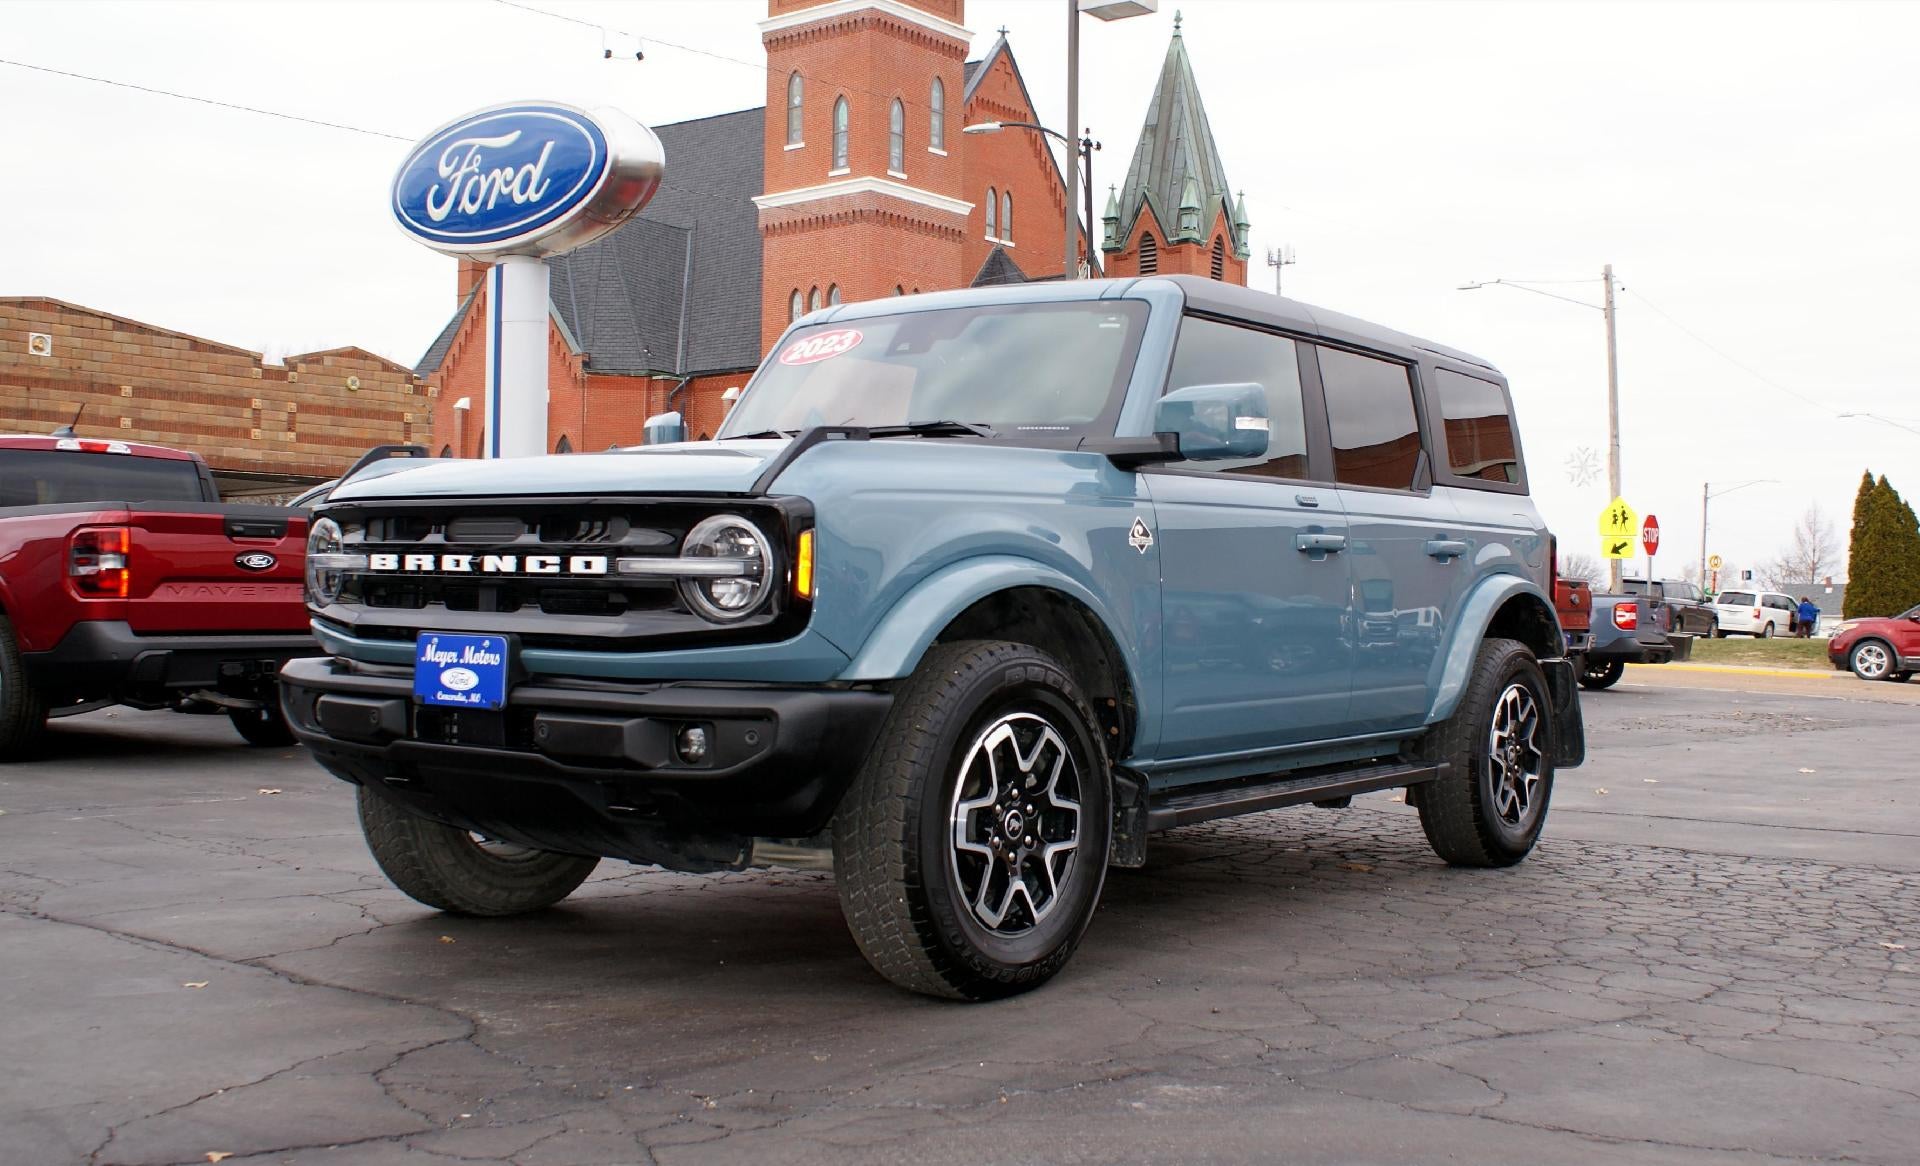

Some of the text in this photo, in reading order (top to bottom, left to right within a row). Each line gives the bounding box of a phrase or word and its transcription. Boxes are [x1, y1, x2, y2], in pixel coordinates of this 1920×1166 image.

[427, 130, 555, 222] Ford
[786, 331, 857, 361] 2023
[1643, 527, 1659, 542] STOP
[370, 553, 608, 574] BRONCO
[421, 637, 500, 667] Meyer Motors
